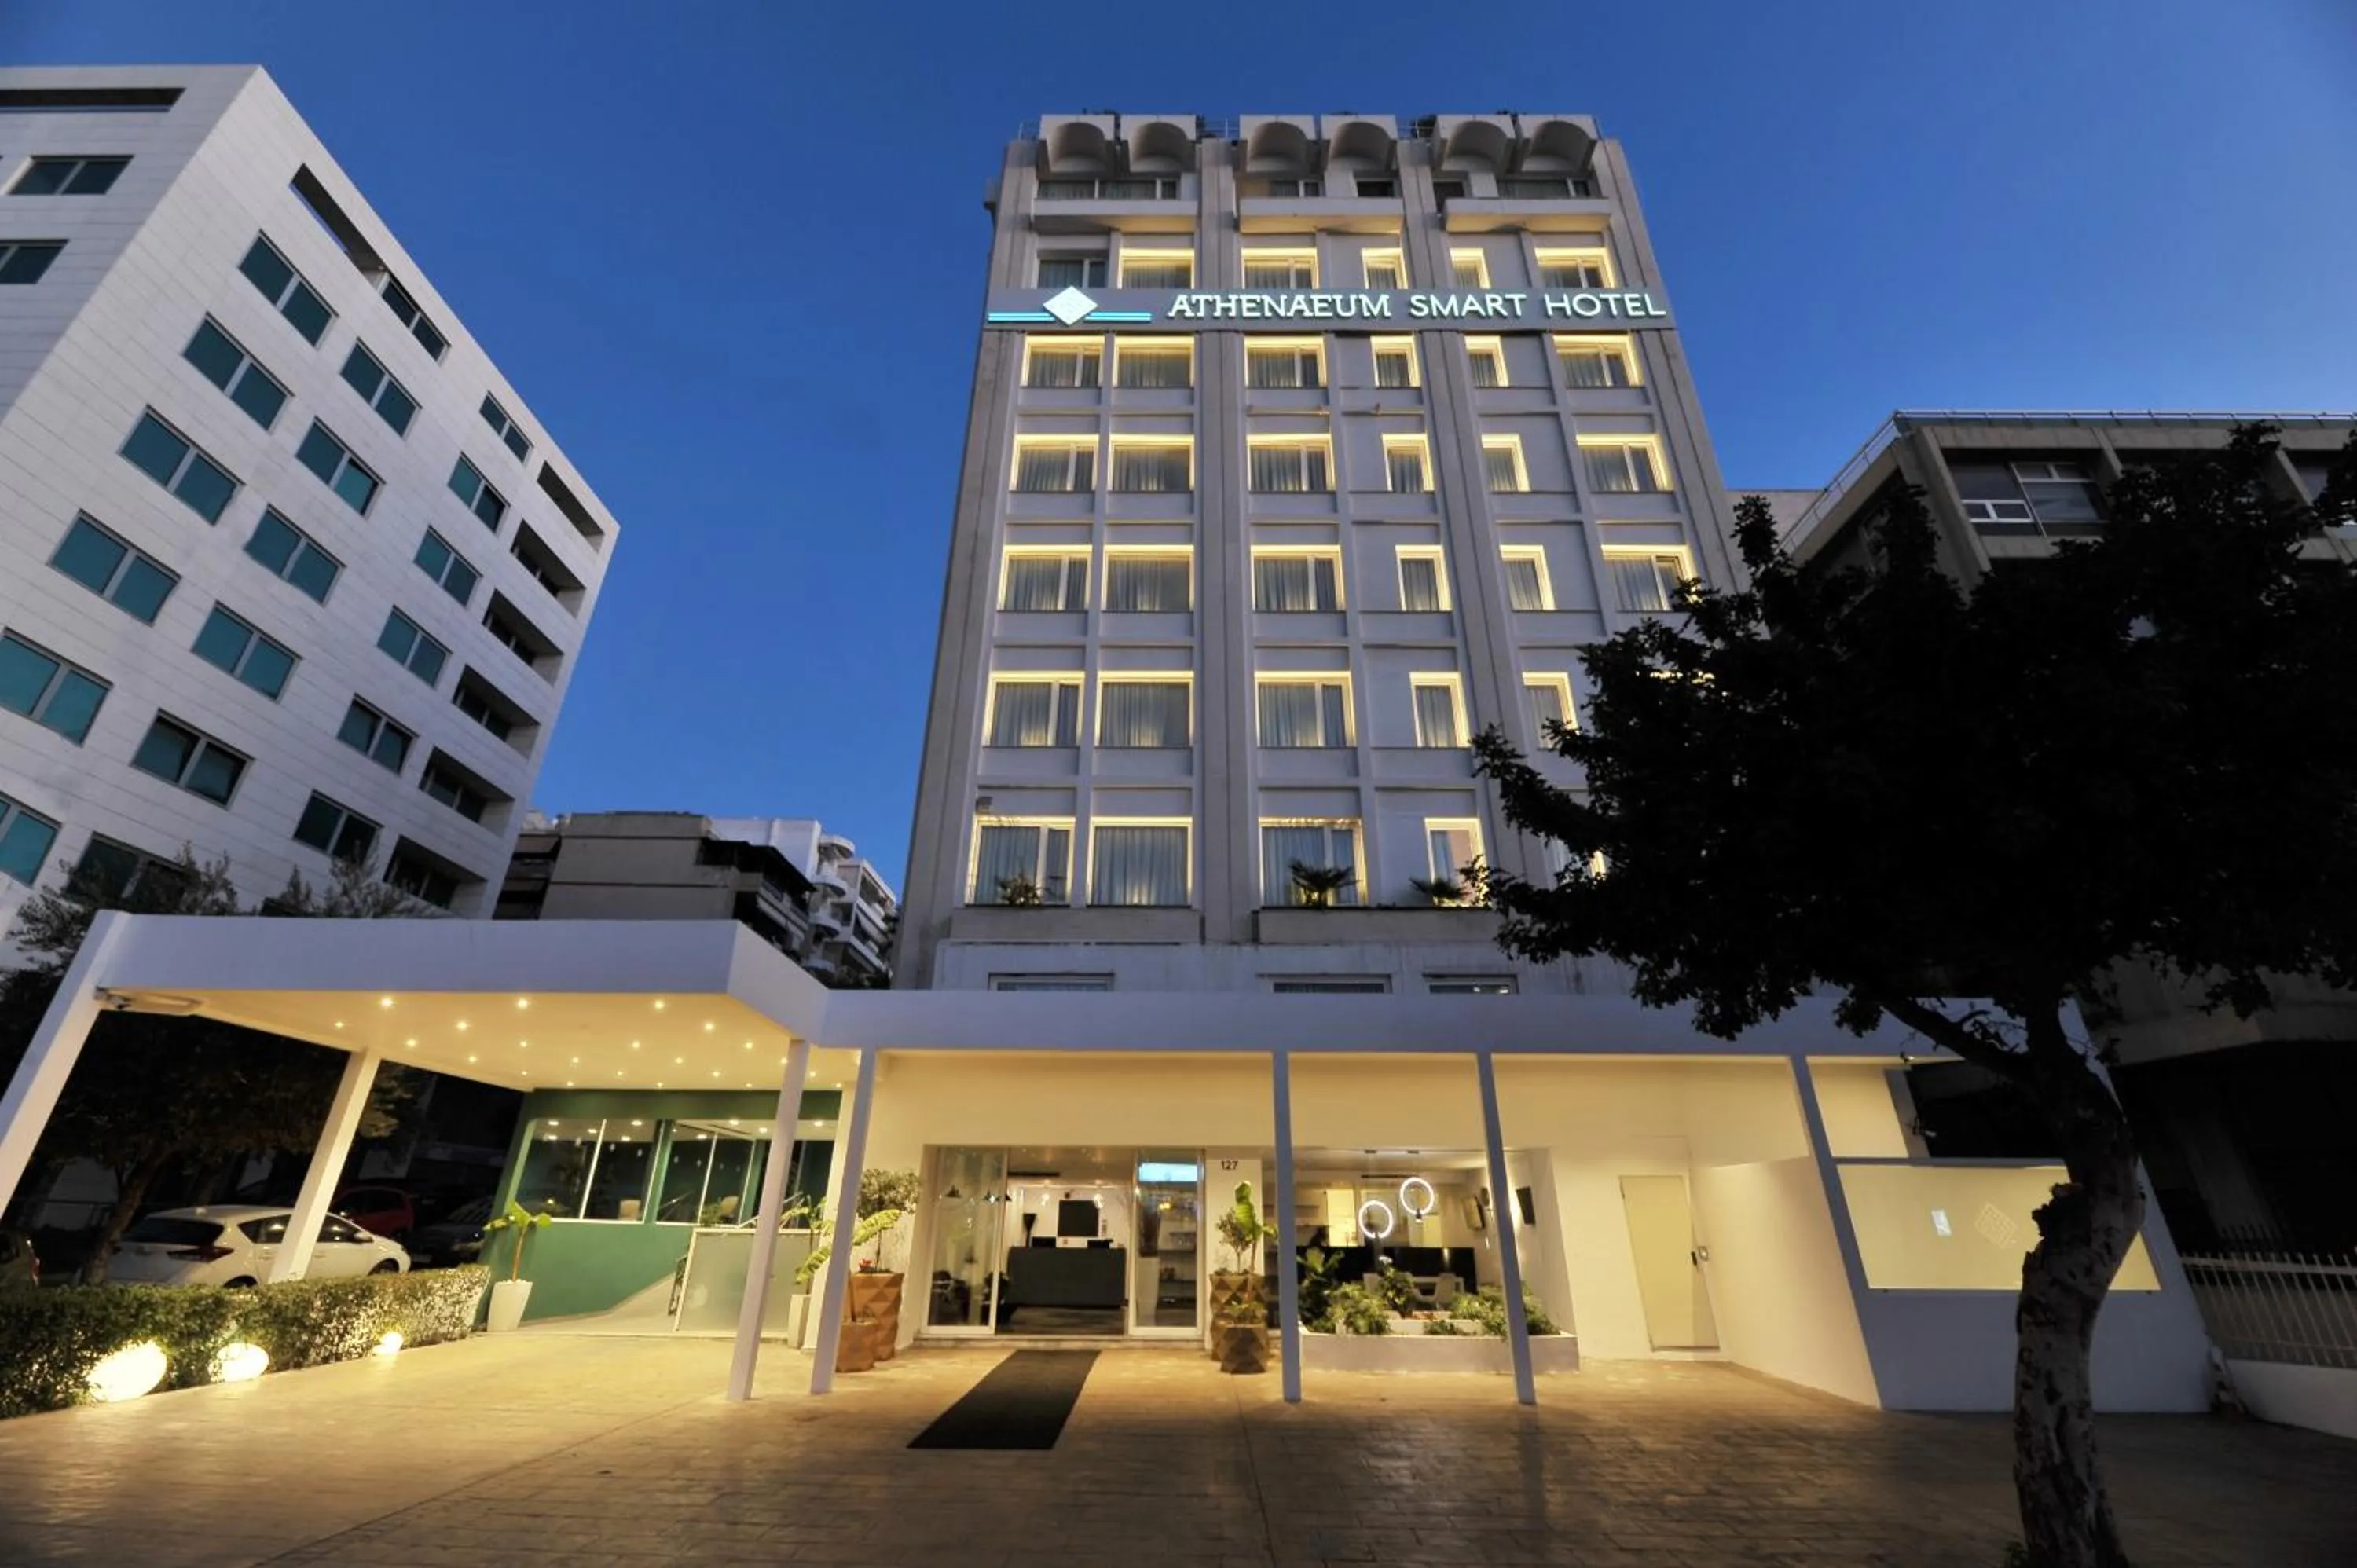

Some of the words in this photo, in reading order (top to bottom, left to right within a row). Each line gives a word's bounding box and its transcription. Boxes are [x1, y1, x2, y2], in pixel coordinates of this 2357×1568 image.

[1168, 293, 1391, 317] ATHENAEUM
[1409, 293, 1527, 317] SMART
[1544, 293, 1666, 317] HOTEL
[1221, 1160, 1238, 1170] 127
